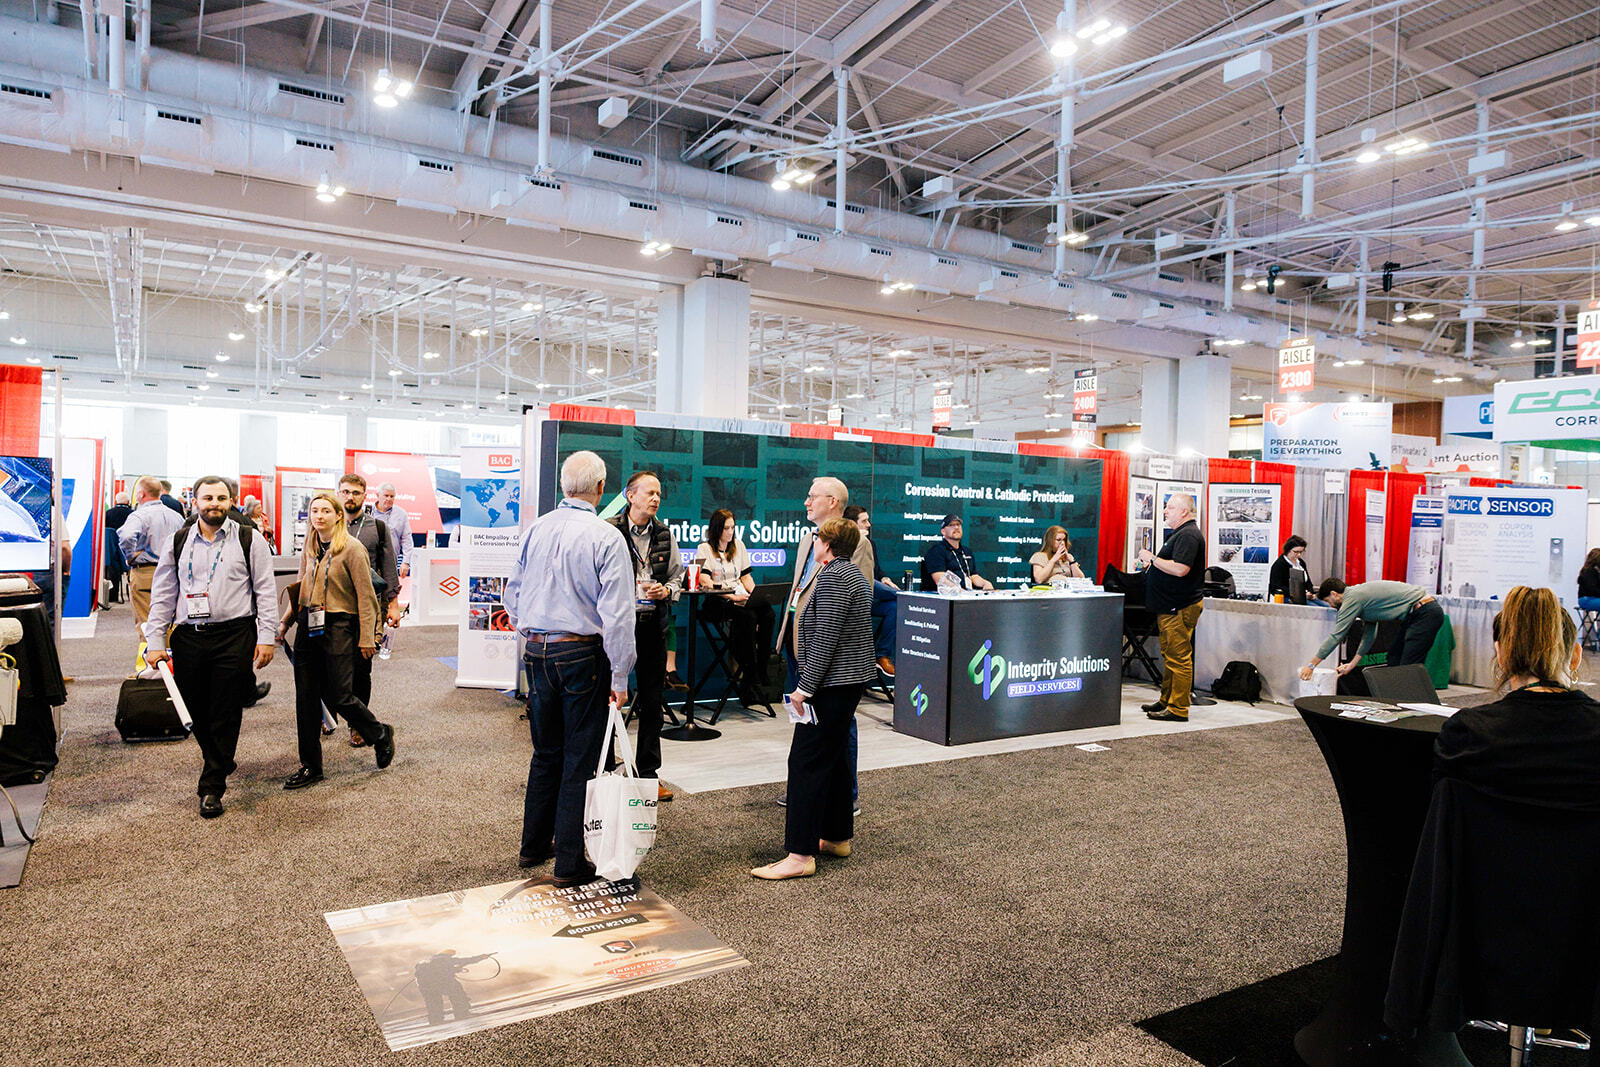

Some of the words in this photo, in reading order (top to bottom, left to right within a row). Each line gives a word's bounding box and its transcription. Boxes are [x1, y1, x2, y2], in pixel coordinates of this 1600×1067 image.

[1584, 314, 1599, 331] AI
[1283, 349, 1311, 365] AISLE
[1581, 340, 1600, 361] 22
[1076, 378, 1095, 391] AISLE
[1281, 370, 1311, 388] 2300
[1075, 396, 1095, 410] 2400
[1555, 416, 1600, 427] CORR
[1270, 447, 1279, 455] IS
[1280, 447, 1342, 455] EVERYTHING
[1454, 453, 1499, 462] Auction
[491, 456, 511, 465] BAC
[905, 482, 950, 498] Corrosion
[952, 485, 984, 500] Control
[985, 487, 993, 500] &
[995, 487, 1031, 502] Cathodic
[1033, 490, 1074, 504] Protection
[1490, 500, 1552, 513] SENSOR
[1497, 530, 1534, 538] ANALYSIS
[1008, 658, 1057, 682] Integrity
[1060, 655, 1110, 675] Solutions
[1009, 684, 1036, 695] FIELD
[1037, 680, 1077, 692] SERVICES
[547, 887, 575, 898] THE
[566, 891, 595, 902] THE
[600, 883, 635, 896] DUST
[569, 900, 605, 913] THIS
[608, 893, 643, 904] WAY.
[575, 911, 597, 921] ON
[567, 923, 605, 935] BOOTH
